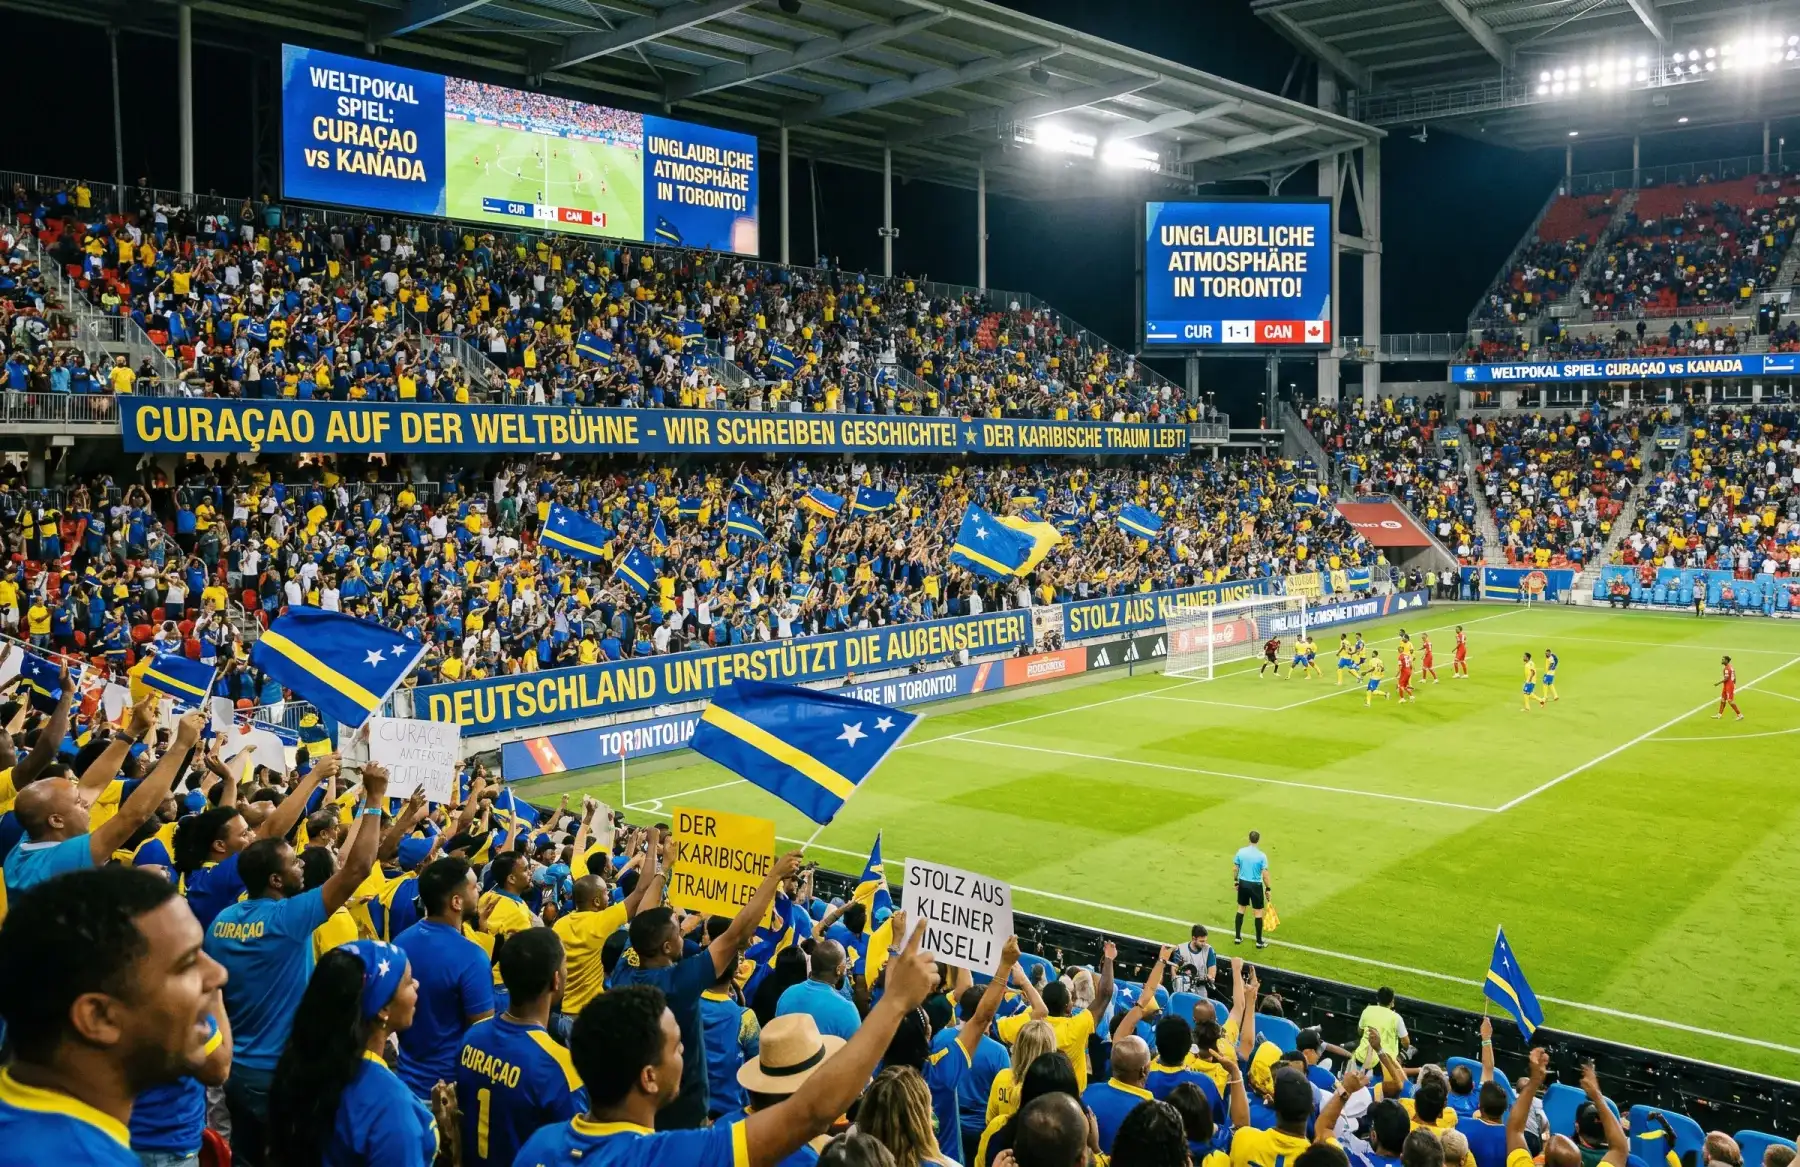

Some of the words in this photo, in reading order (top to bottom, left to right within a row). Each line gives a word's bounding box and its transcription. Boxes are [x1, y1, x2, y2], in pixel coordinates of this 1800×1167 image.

[310, 67, 419, 105] WELTPOKAL
[337, 96, 394, 124] SPIEL:
[312, 117, 418, 156] CURAÇAO
[304, 149, 330, 169] vs
[336, 151, 426, 183] KANADA
[648, 136, 754, 172] UNGLAUBLICHE
[653, 161, 749, 192] ATMOSPHÄRE
[508, 203, 526, 215] CUR
[566, 211, 583, 222] CAN
[657, 182, 674, 202] IN
[676, 184, 747, 212] TORONTO!
[1161, 225, 1315, 247] UNGLAUBLICHE
[1168, 247, 1307, 272] ATMOSPHÄRE
[1174, 276, 1195, 297] IN
[1200, 277, 1302, 298] TORONTO!
[1184, 324, 1213, 338] CUR
[1264, 325, 1293, 339] CAN
[1491, 364, 1560, 379] WELTPOKAL
[1564, 363, 1602, 377] SPIEL:
[1605, 362, 1665, 379] CURAÇAO
[1669, 363, 1684, 374] vs
[1687, 359, 1743, 373] KANADA
[136, 405, 315, 452] CURAÇAO
[326, 411, 390, 443] AUF
[400, 412, 464, 444] DER
[471, 409, 639, 444] WELTBÜHNE
[663, 417, 709, 445] WIR
[717, 417, 835, 446] SCHREIBEN
[841, 420, 957, 447] GESCHICHTE!
[983, 424, 1015, 448] DER
[1018, 425, 1102, 449] KARIBISCHE
[1105, 427, 1150, 449] TRAUM
[1154, 428, 1186, 449] LEBT!
[1070, 602, 1121, 633] STOLZ
[1124, 598, 1155, 625] AUS
[1157, 589, 1217, 619] KLEINER
[429, 666, 656, 727] DEUTSCHLAND
[664, 640, 839, 695] UNTERSTÜTZT
[846, 634, 880, 667] DIE
[884, 685, 897, 704] IN
[899, 674, 957, 701] TORONTO!
[680, 813, 716, 838] DER
[677, 841, 771, 878] KARIBISCHE
[674, 872, 728, 903] TRAUM
[909, 865, 966, 896] STOLZ
[970, 879, 1004, 907] AUS
[917, 896, 994, 935] KLEINER
[213, 920, 265, 943] CURAÇAO
[461, 1044, 521, 1090] CURAÇAO
[477, 1088, 491, 1160] 1
